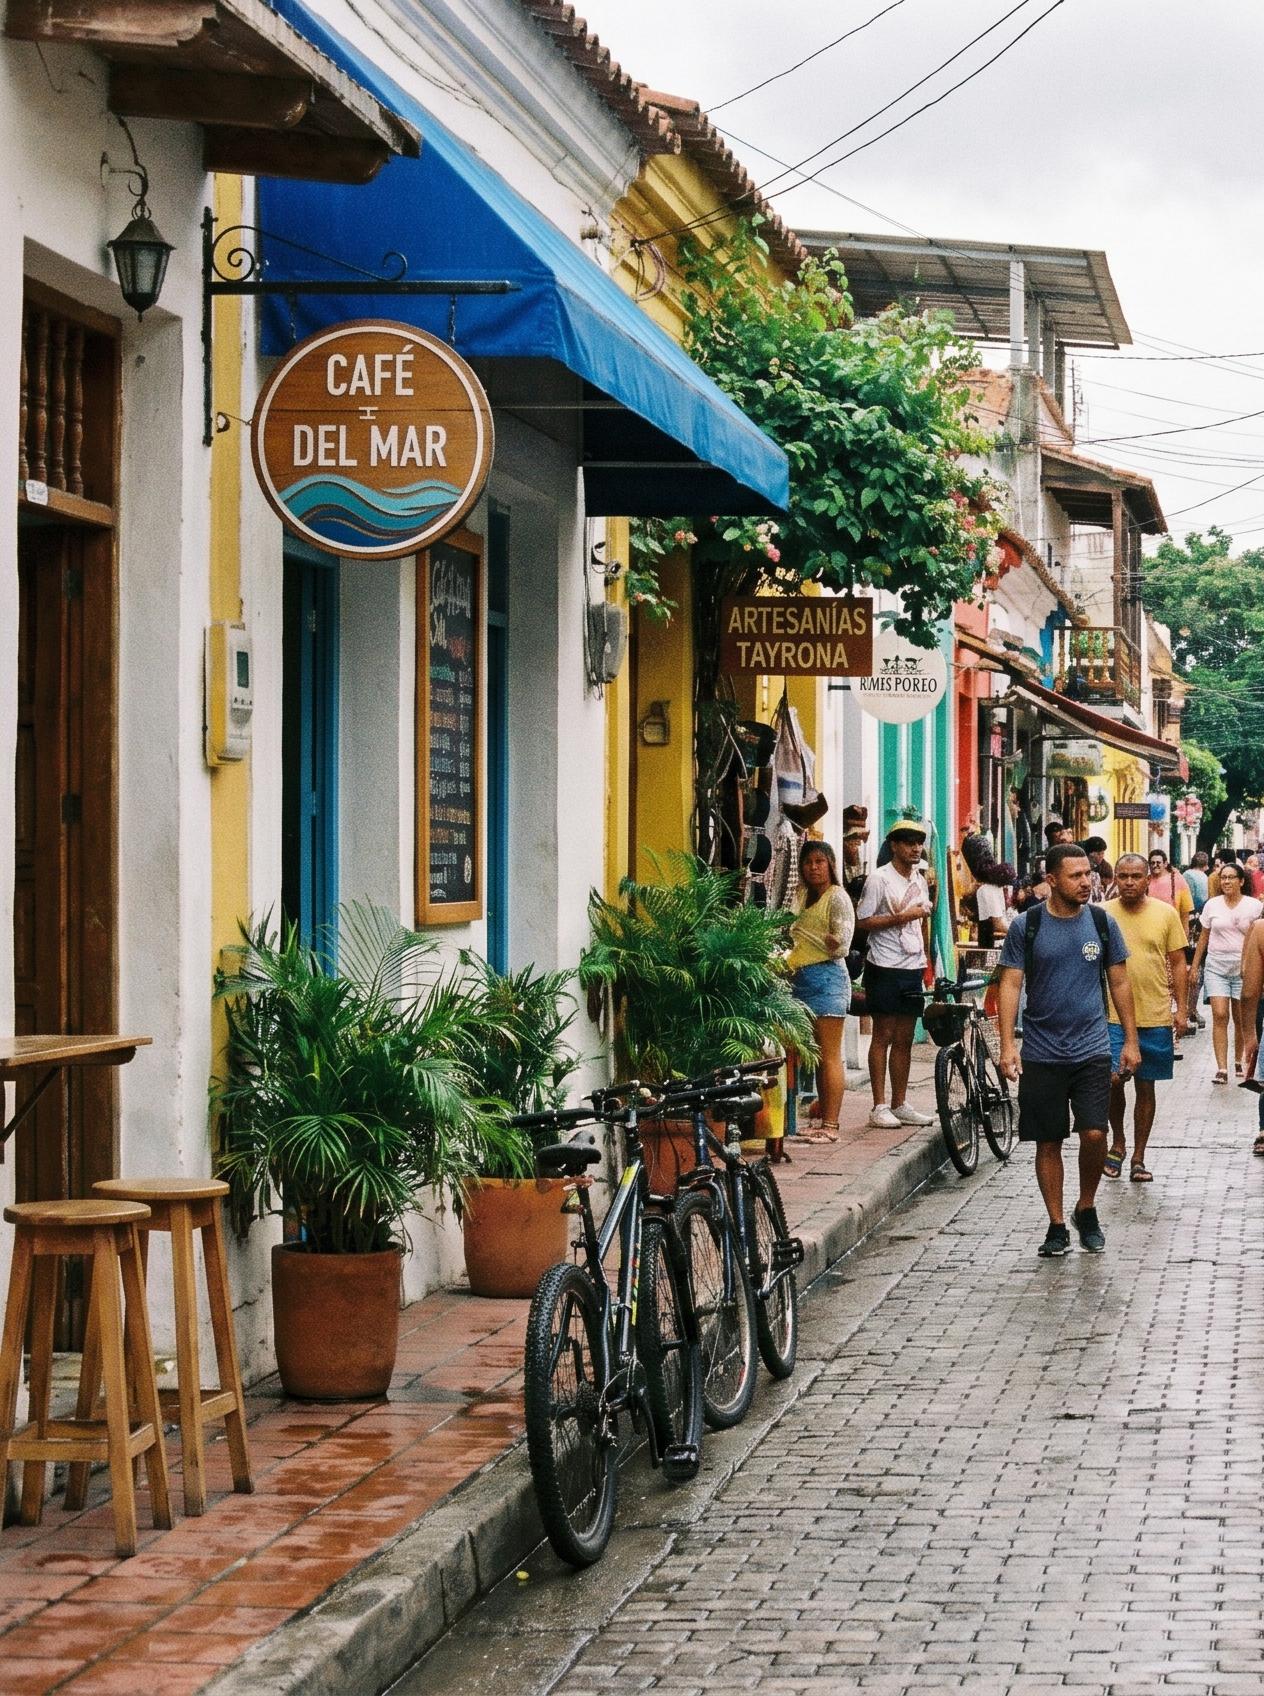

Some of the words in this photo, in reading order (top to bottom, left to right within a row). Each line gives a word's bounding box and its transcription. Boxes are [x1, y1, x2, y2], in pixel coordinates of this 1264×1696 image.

[327, 344, 414, 396] CAFÉ
[293, 424, 358, 467] DEL
[370, 425, 447, 467] MAR
[727, 601, 867, 635] ARTESANÍAS
[736, 641, 849, 668] TAYRONA
